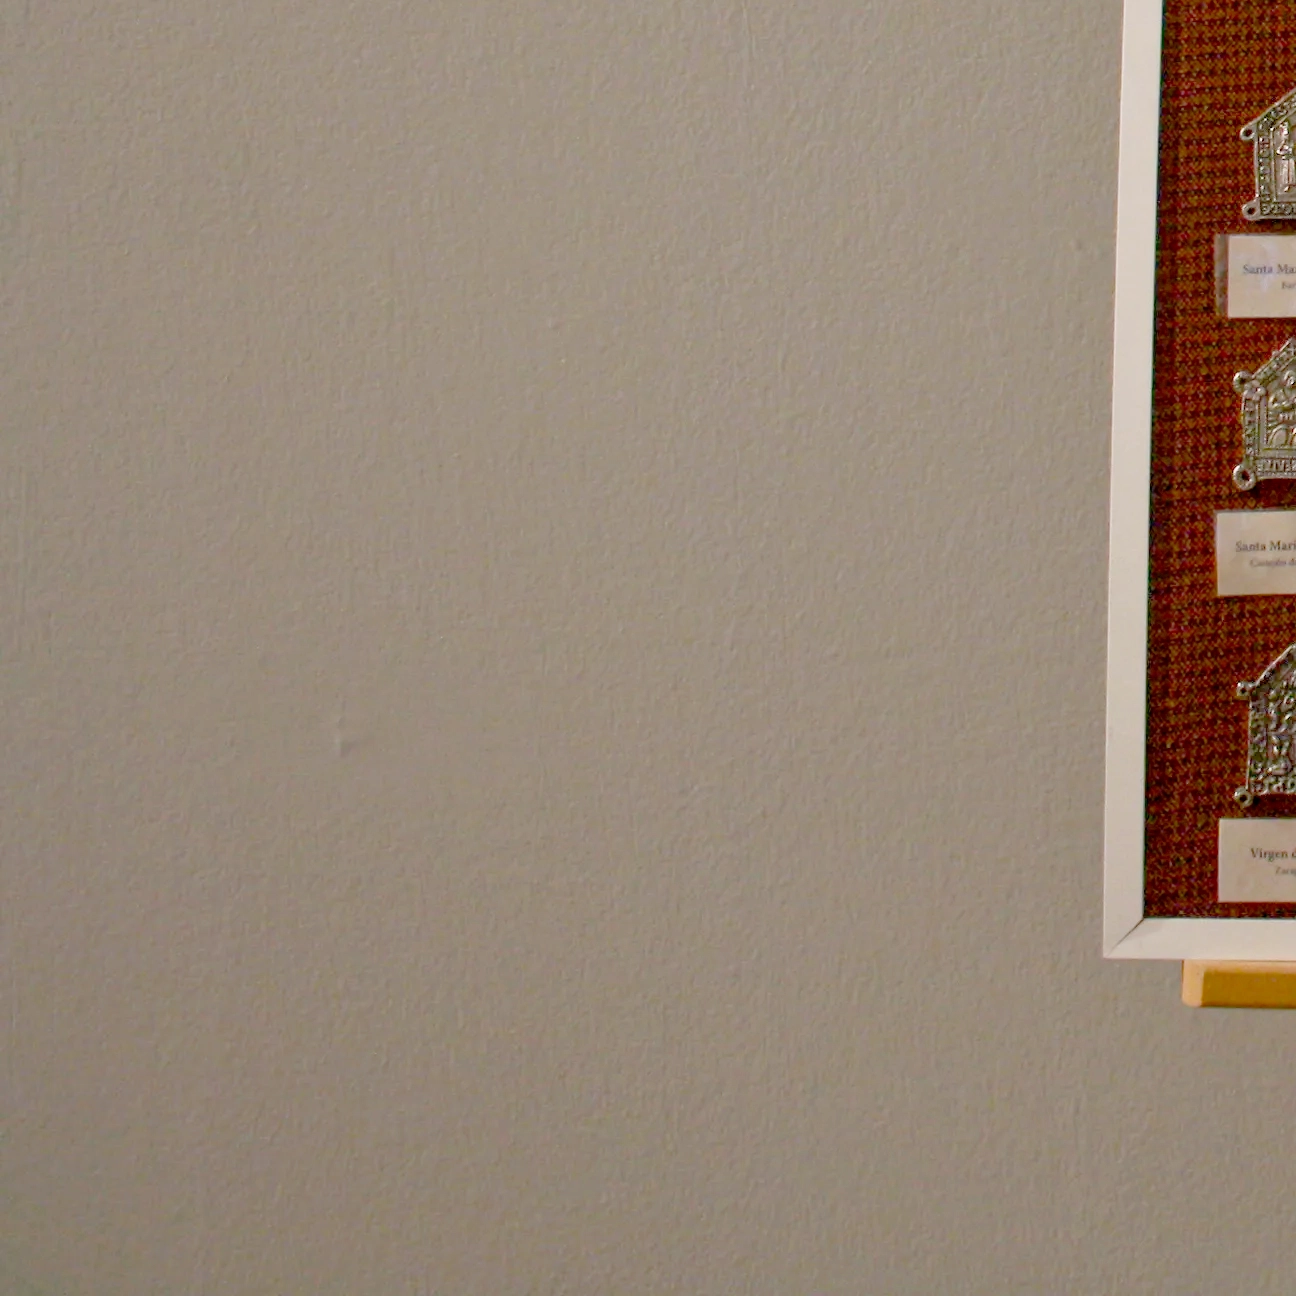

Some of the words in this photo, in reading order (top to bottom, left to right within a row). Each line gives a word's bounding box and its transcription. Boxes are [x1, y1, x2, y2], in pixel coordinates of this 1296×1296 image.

[1242, 263, 1273, 274] Santa
[1235, 540, 1266, 552] Santa
[1250, 847, 1288, 862] Virgen
